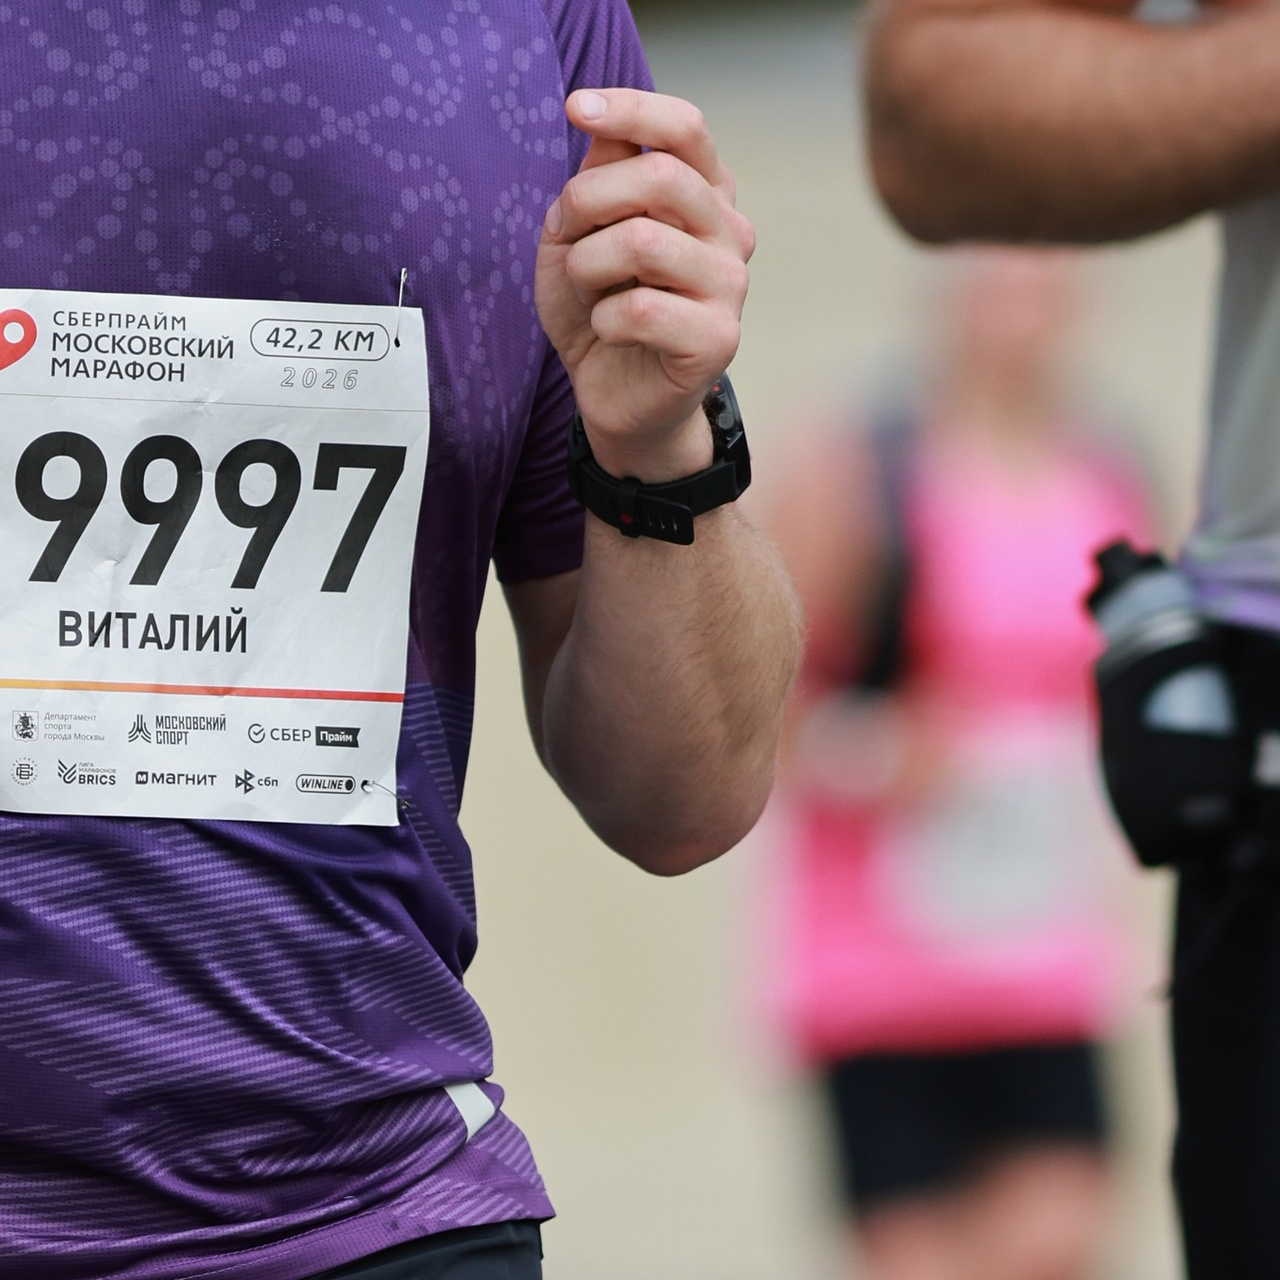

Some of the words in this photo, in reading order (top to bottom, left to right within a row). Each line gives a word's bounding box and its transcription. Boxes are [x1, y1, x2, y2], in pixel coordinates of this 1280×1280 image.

[53, 310, 186, 331] СБЕРПРАЙМ
[52, 332, 234, 359] МОСКОВСКИЙ
[265, 327, 323, 352] 42,2
[50, 357, 185, 382] МАРАФОН
[280, 366, 358, 390] 2026
[58, 607, 248, 653] ВИТАЛИЙ
[44, 712, 97, 722] Департамент
[156, 714, 226, 731] МОСКОВСКИЙ
[44, 723, 72, 731] спорта
[44, 733, 72, 741] города
[74, 733, 105, 741] Москвы
[156, 731, 189, 745] СПОРТ
[270, 728, 312, 741] СБЕР
[320, 730, 353, 743] Прайм
[78, 774, 117, 786] BRICS
[151, 772, 217, 786] магнит
[257, 776, 278, 787] сбп
[300, 778, 344, 790] WINLINE
